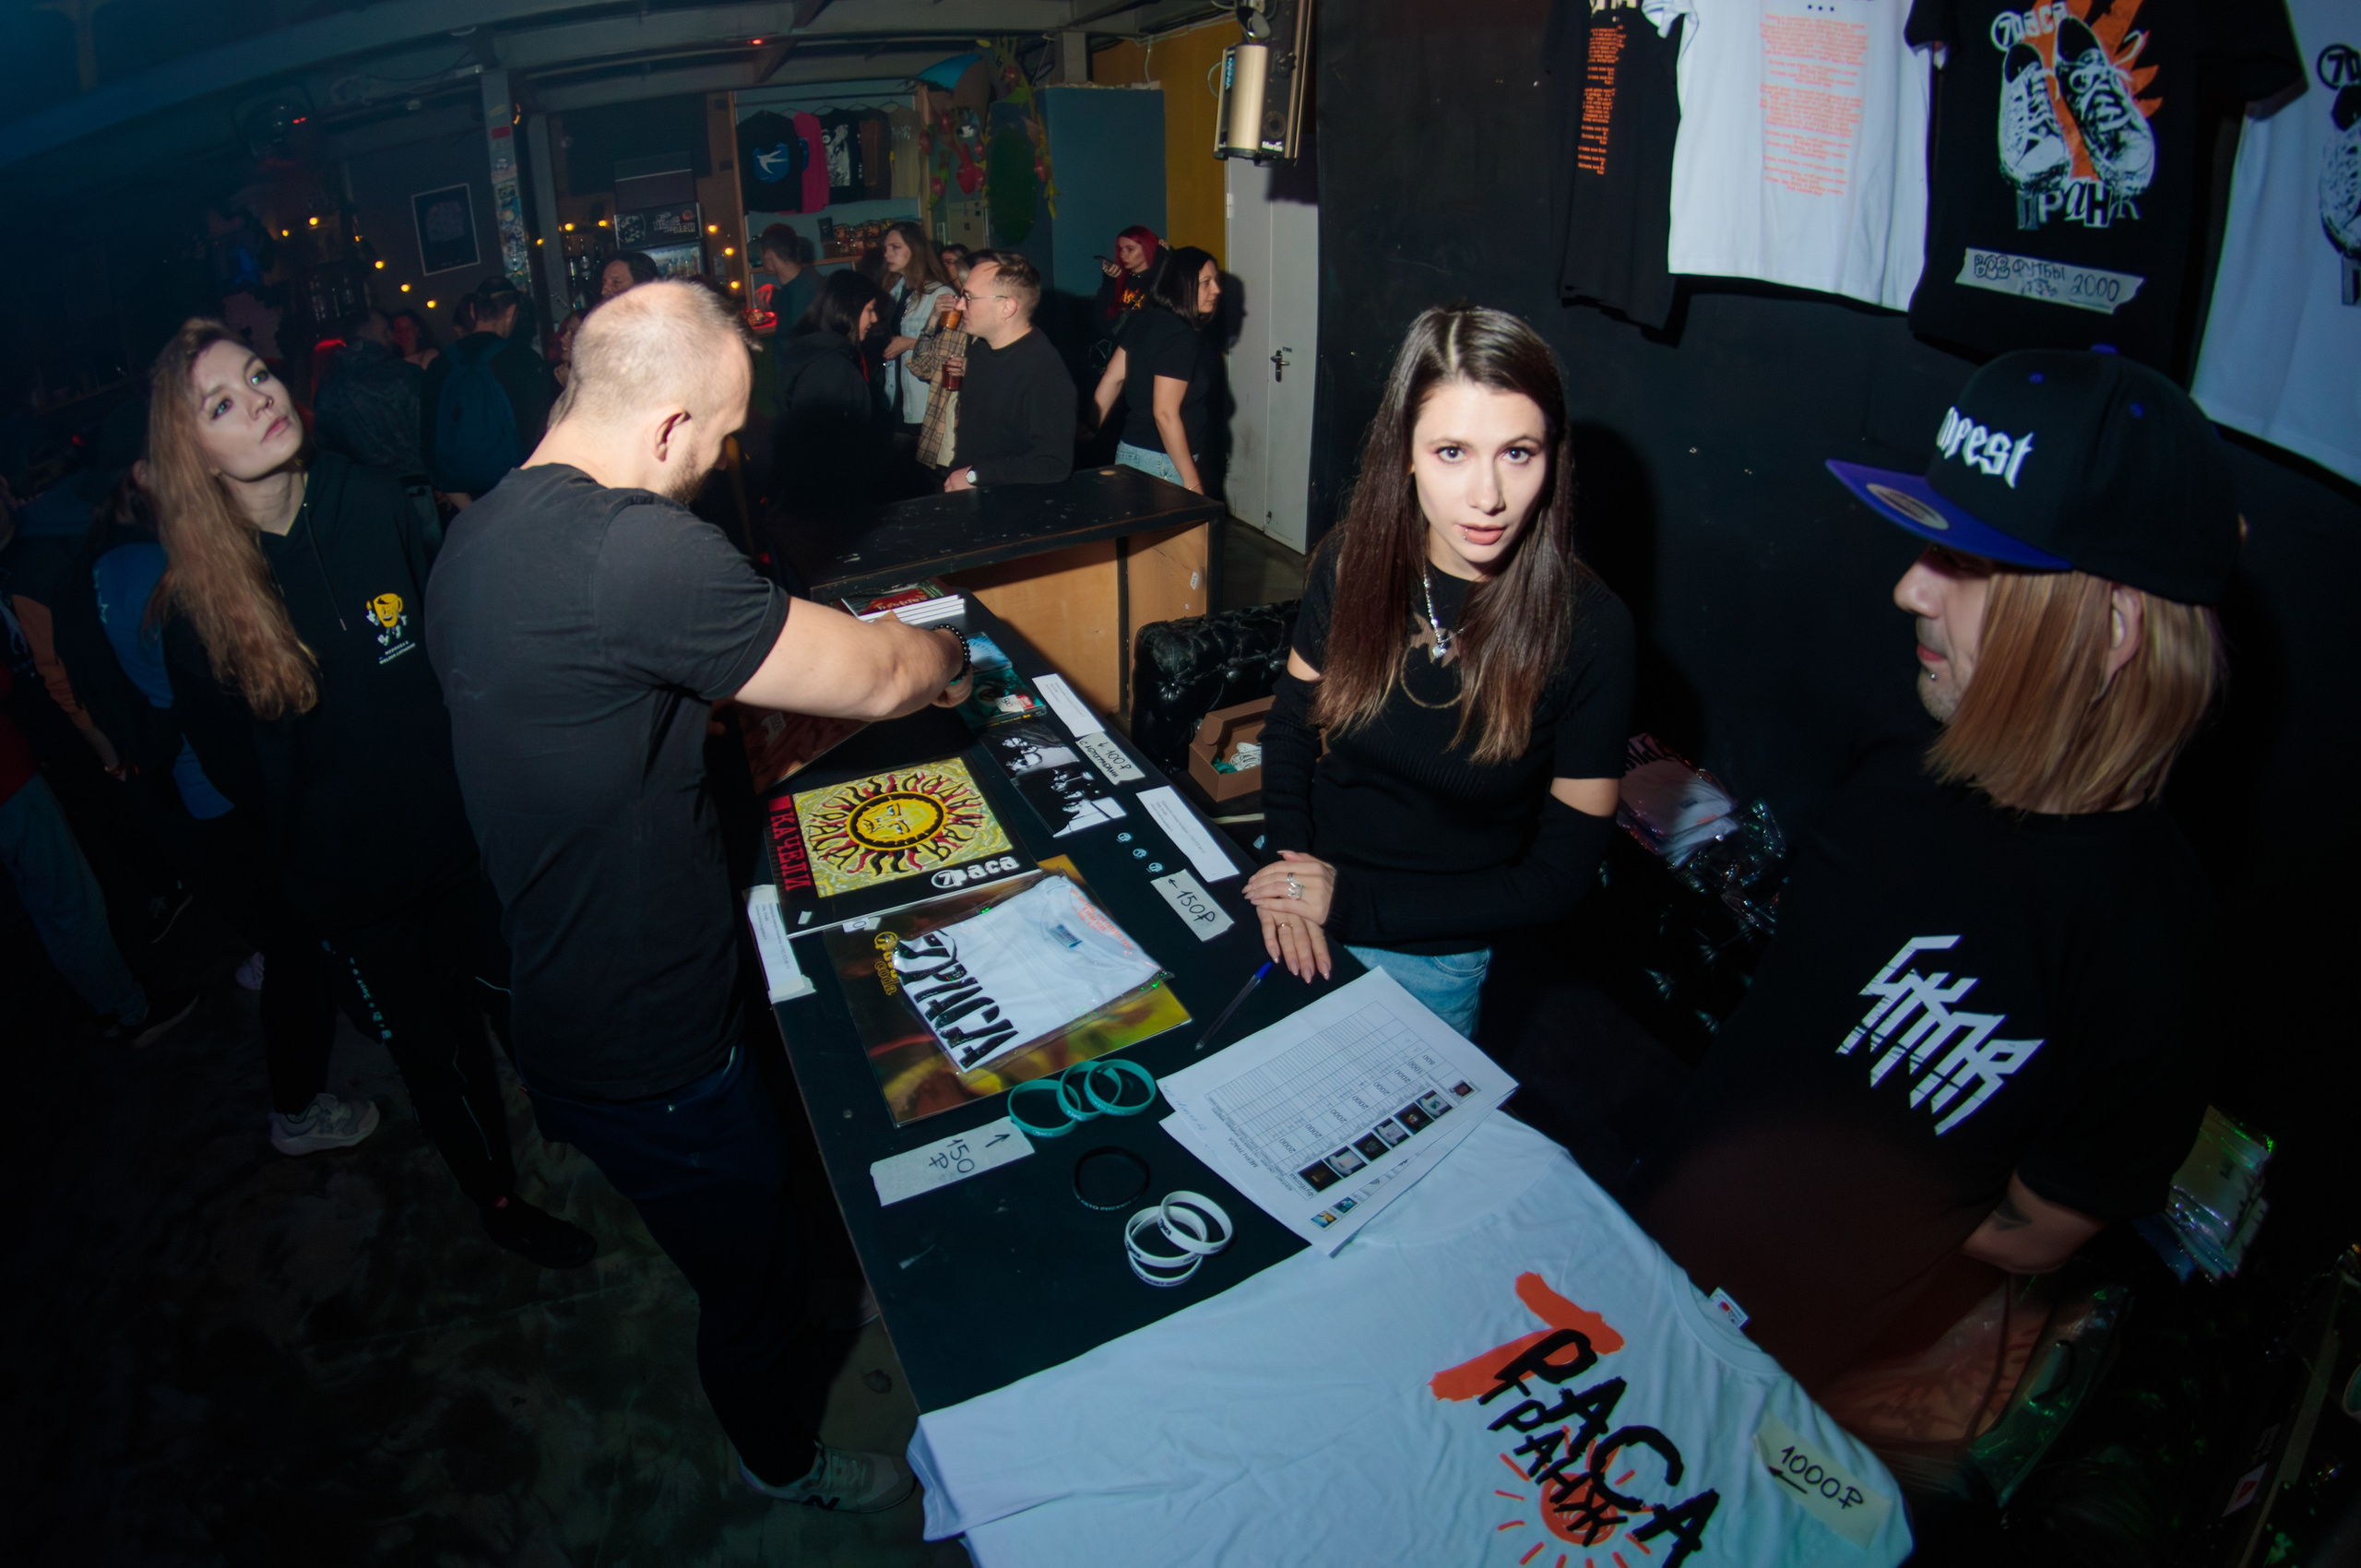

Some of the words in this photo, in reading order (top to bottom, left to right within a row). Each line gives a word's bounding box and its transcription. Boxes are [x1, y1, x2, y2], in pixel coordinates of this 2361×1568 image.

[1262, 140, 1284, 152] Martin
[2072, 274, 2121, 302] 2000
[770, 809, 812, 893] КАЧЕЛИ
[1175, 886, 1216, 925] 150₽
[874, 960, 897, 996] coda
[1407, 1059, 1424, 1075] 1000
[1394, 1068, 1411, 1084] 2000
[1373, 1080, 1390, 1096] 2000
[1352, 1094, 1369, 1111] 2000
[1330, 1108, 1347, 1124] 2000
[1305, 1123, 1322, 1139] 2000
[1228, 1136, 1244, 1154] 7РАСА
[1278, 1137, 1297, 1154] 2000
[945, 1137, 975, 1173] 150
[1242, 1153, 1258, 1169] МЕРЧ
[1289, 1171, 1315, 1197] Футболка
[1780, 1445, 1864, 1511] 1000₽
